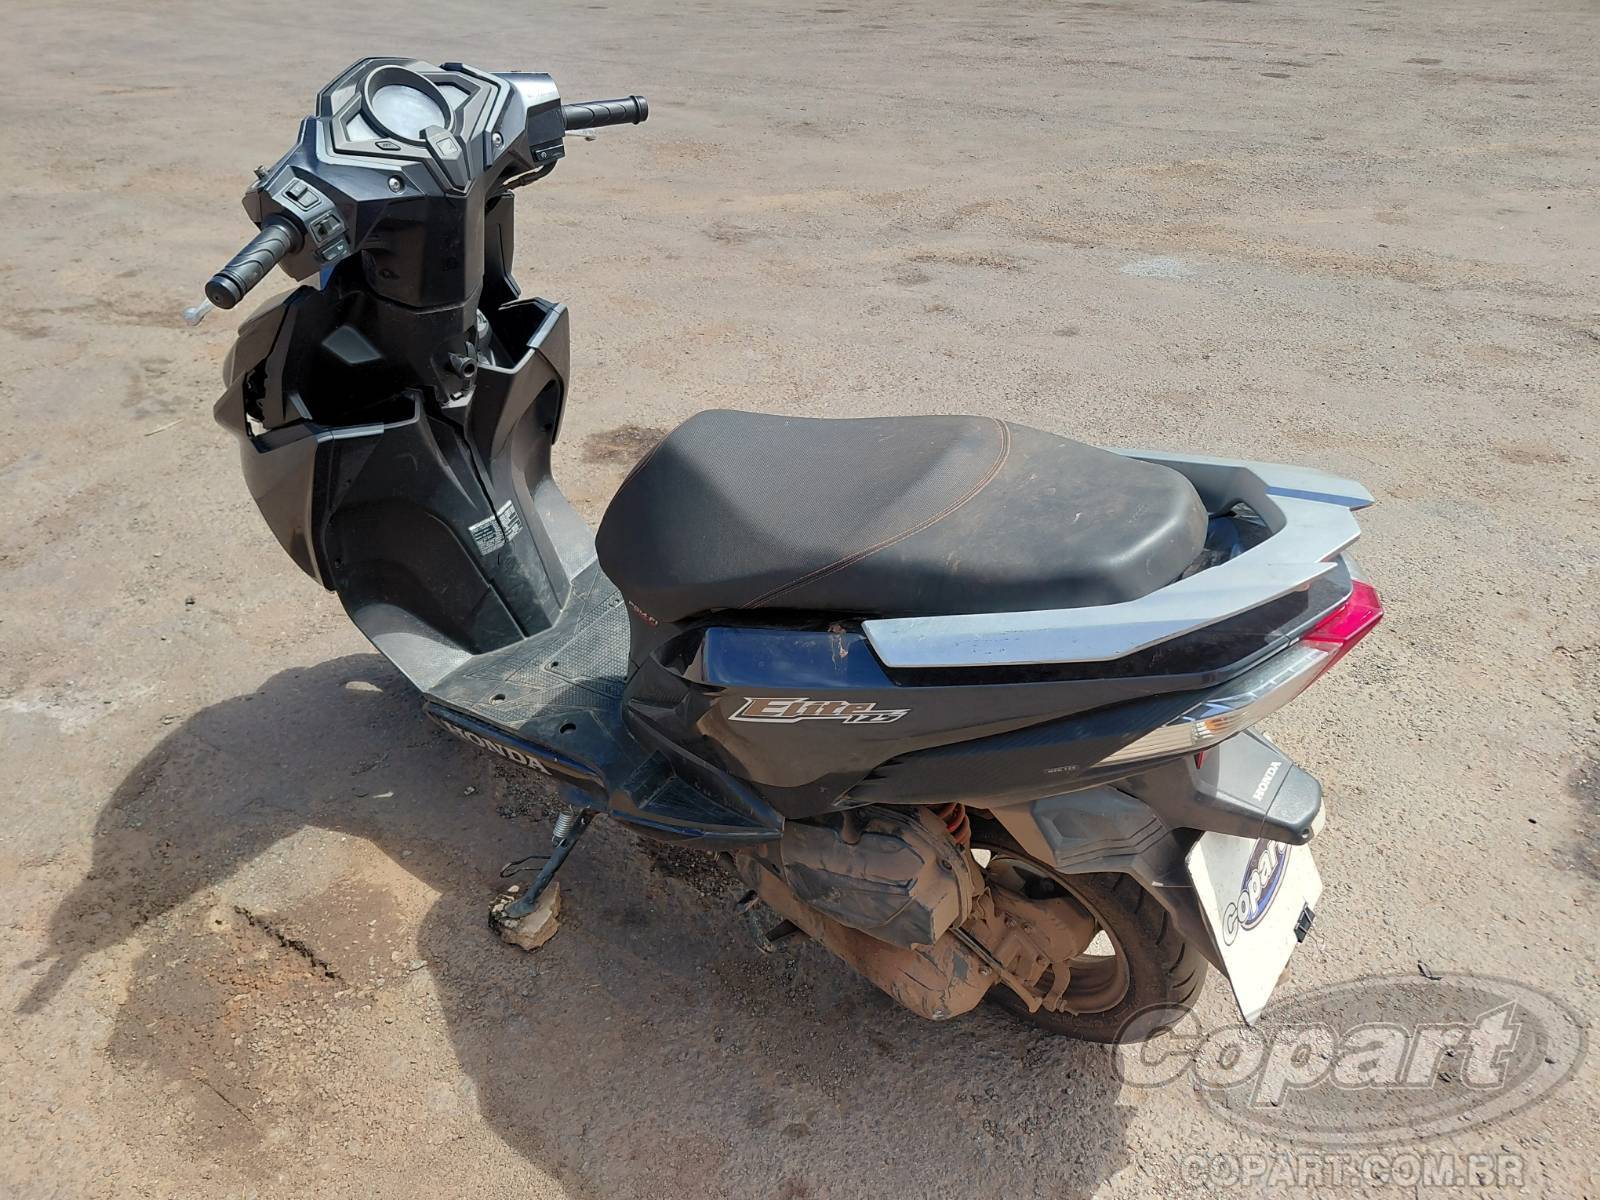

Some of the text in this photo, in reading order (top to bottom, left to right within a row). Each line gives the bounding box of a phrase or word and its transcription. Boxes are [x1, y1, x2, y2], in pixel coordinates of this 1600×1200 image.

[738, 697, 876, 720] Elite
[440, 718, 553, 776] HONDA
[1254, 760, 1283, 802] HONDA
[1222, 839, 1287, 946] Copar
